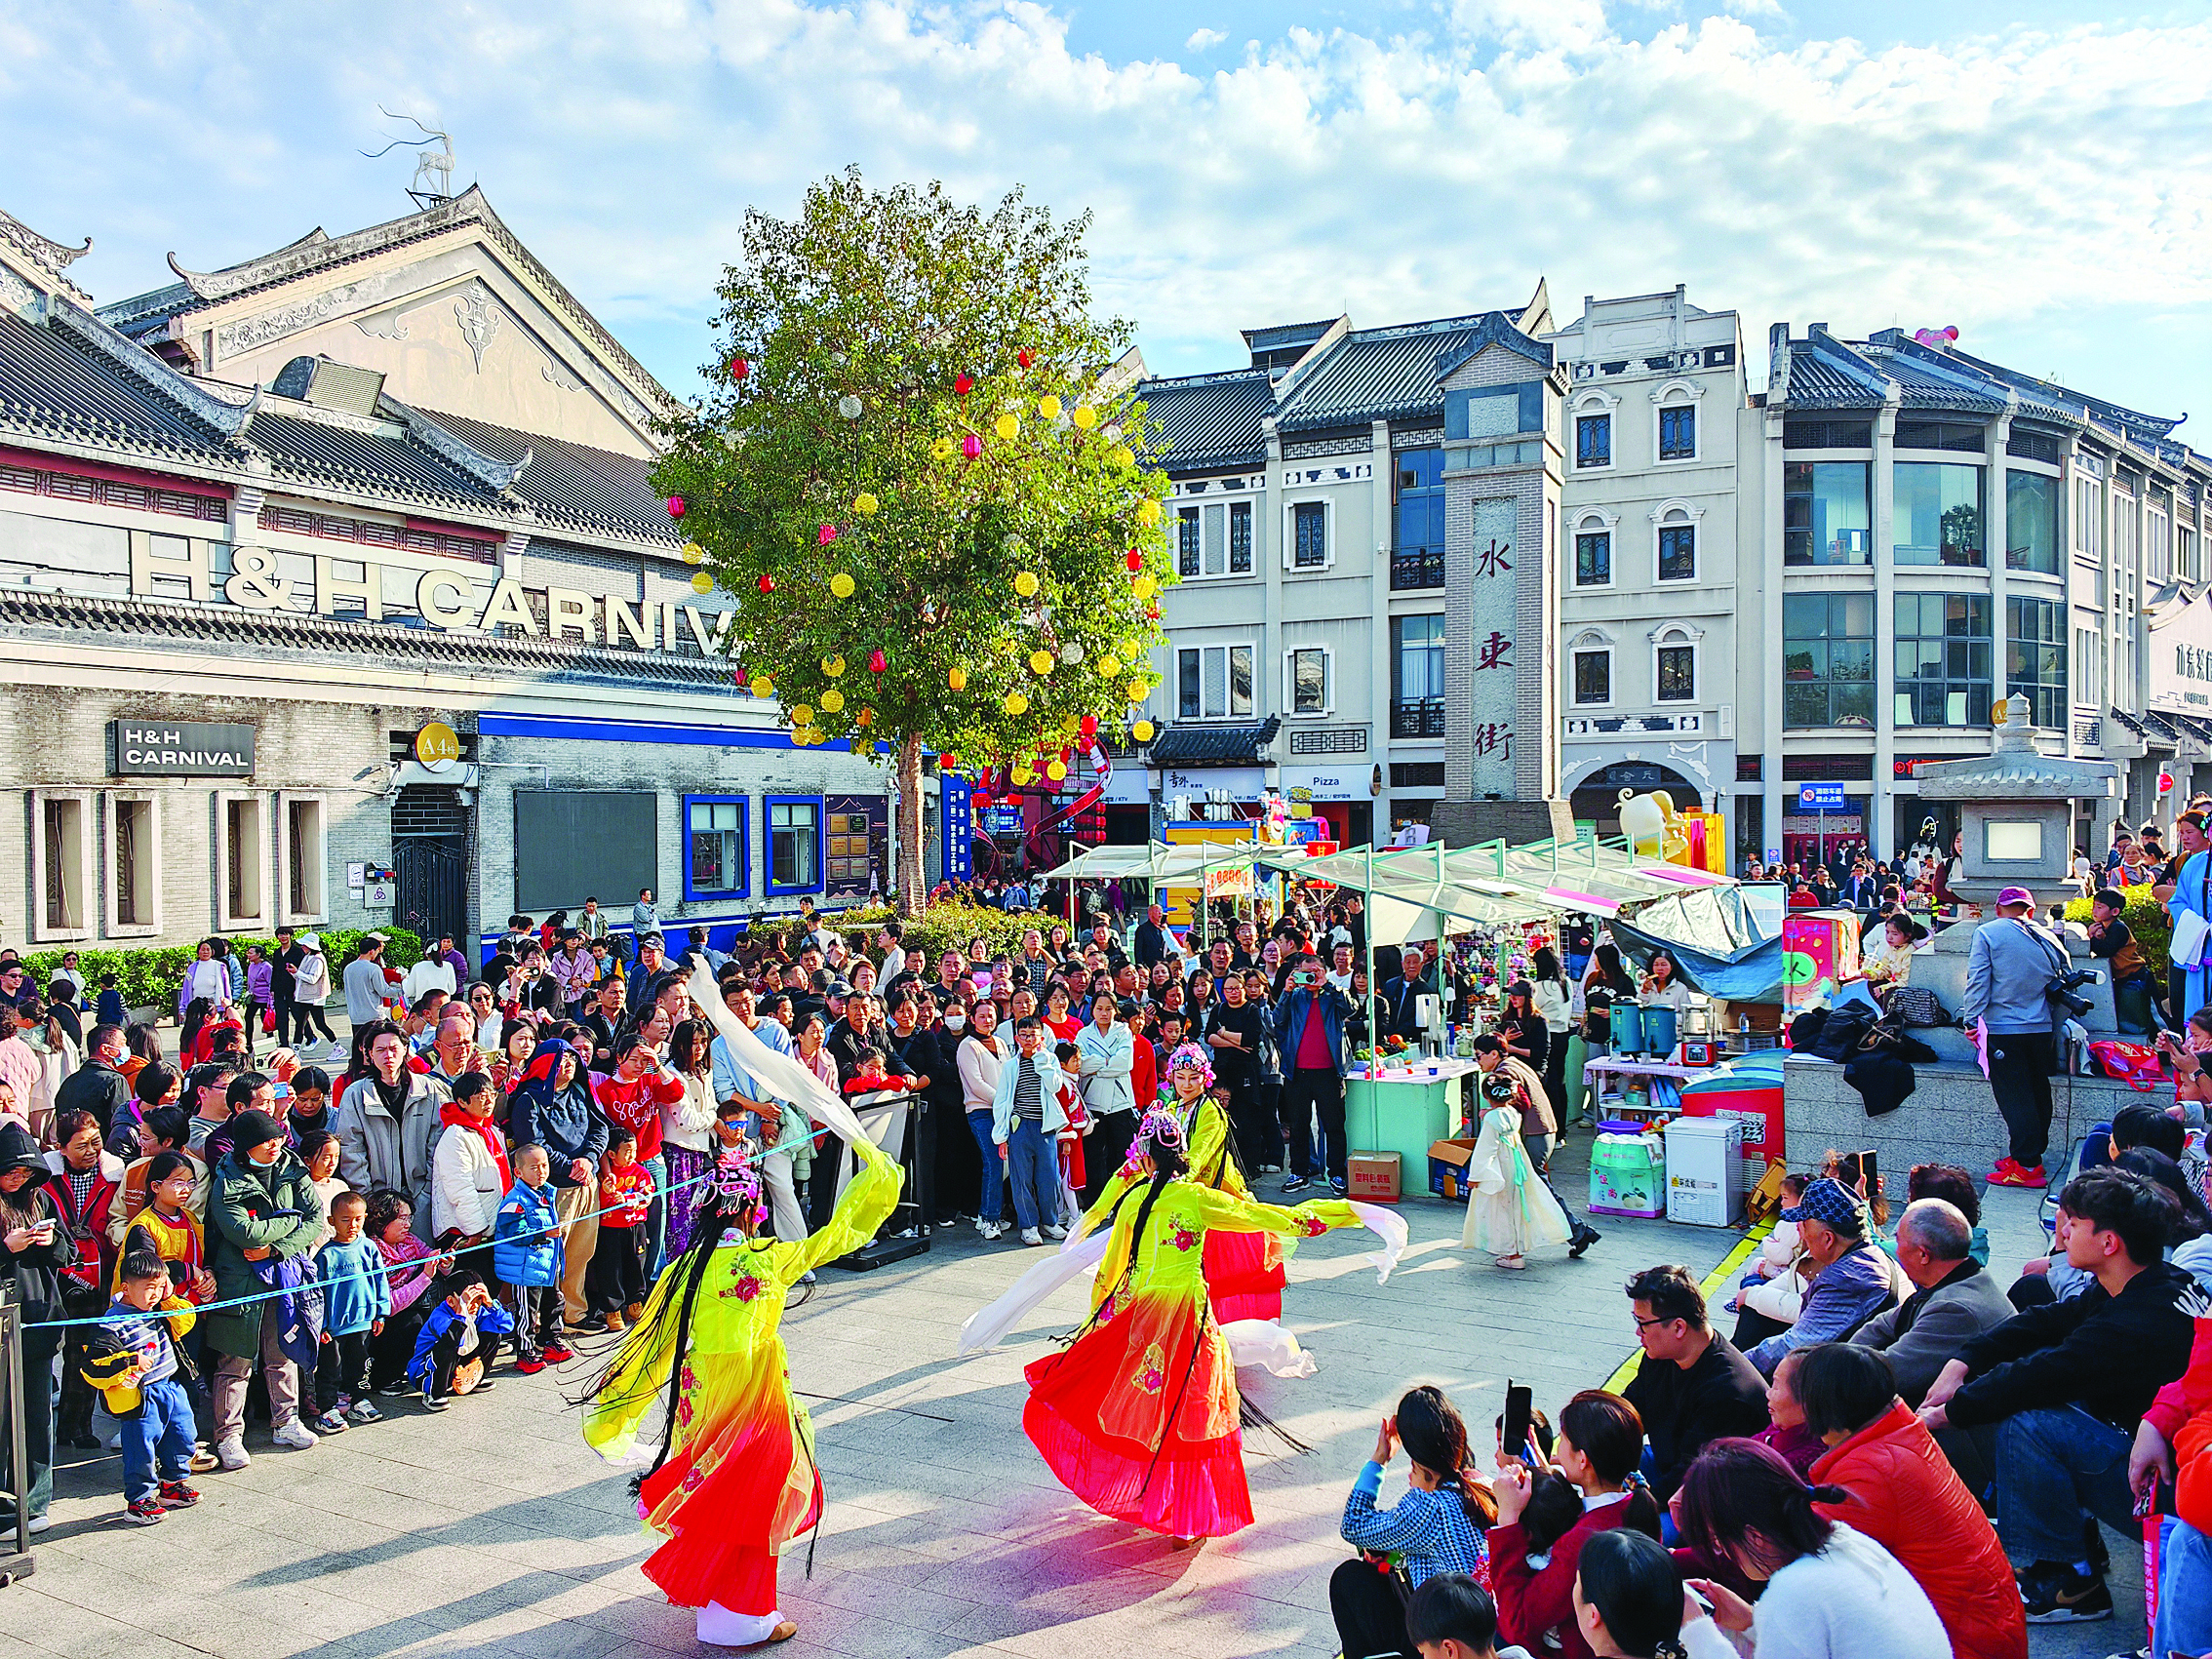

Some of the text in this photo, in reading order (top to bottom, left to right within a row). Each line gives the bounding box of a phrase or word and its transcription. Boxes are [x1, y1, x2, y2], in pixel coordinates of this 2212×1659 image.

[128, 530, 383, 622] H&H
[1475, 538, 1514, 762] 水東街
[125, 729, 180, 744] H&H
[125, 750, 249, 767] CARNIVAL
[1313, 776, 1340, 786] Pizza
